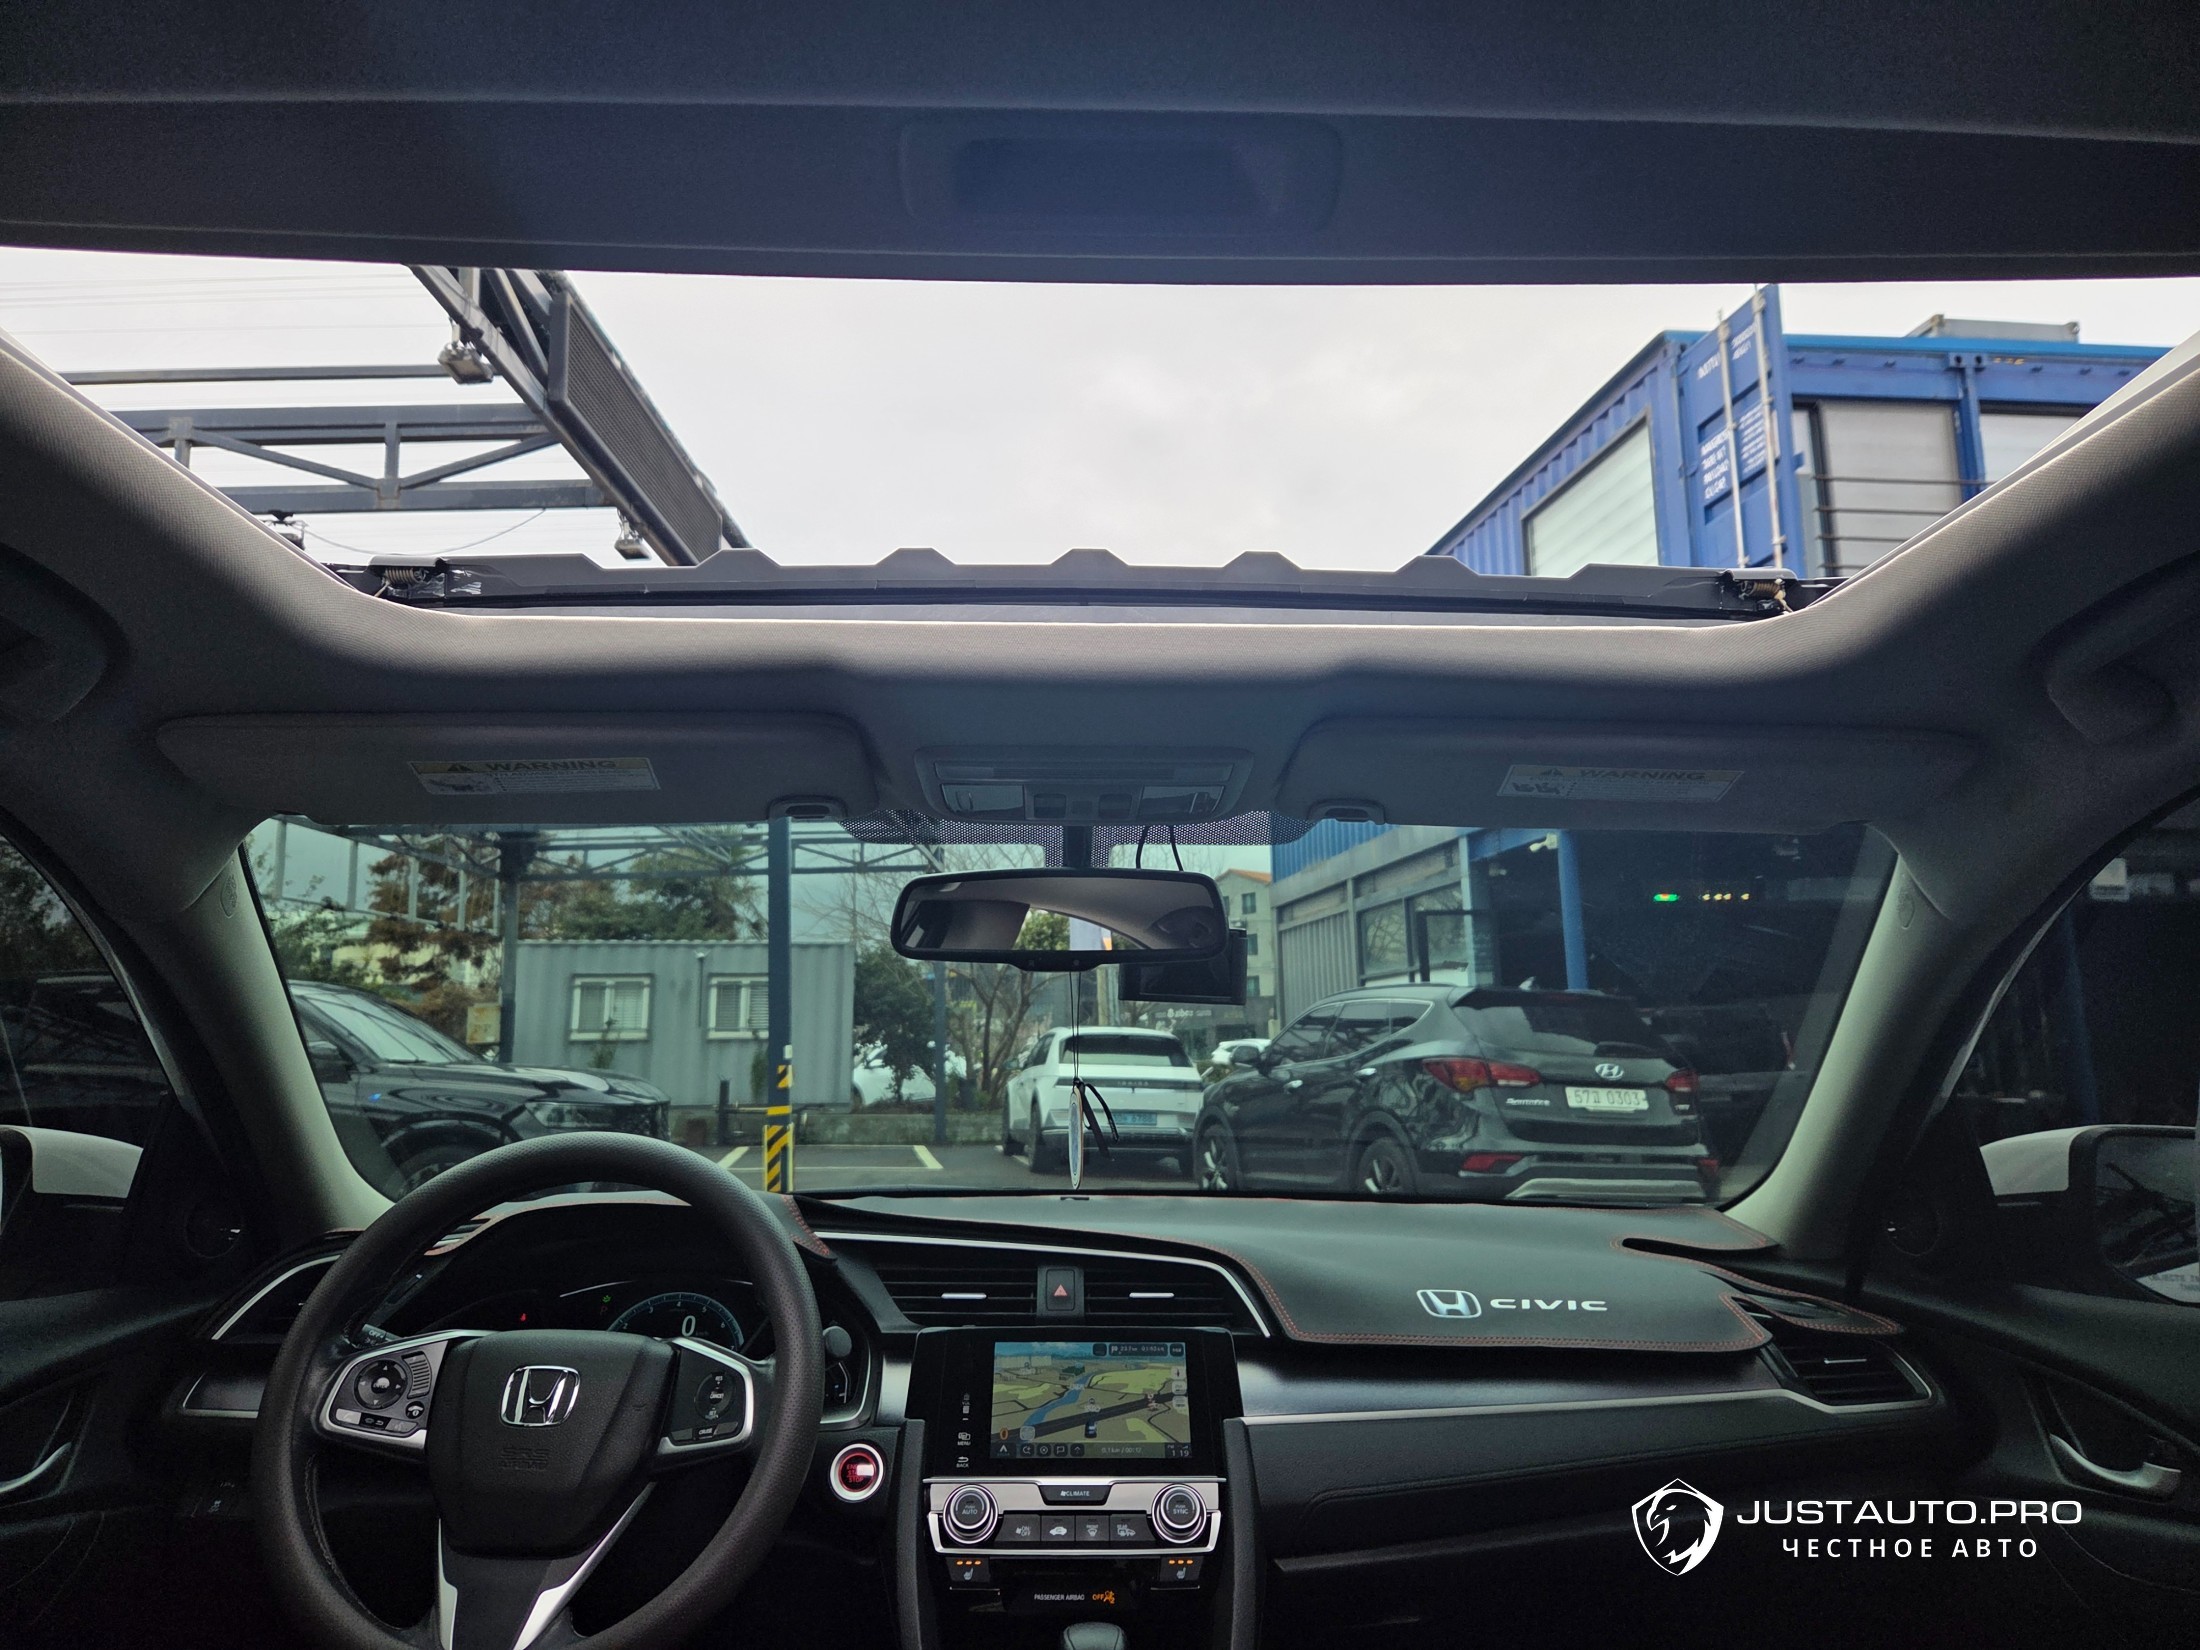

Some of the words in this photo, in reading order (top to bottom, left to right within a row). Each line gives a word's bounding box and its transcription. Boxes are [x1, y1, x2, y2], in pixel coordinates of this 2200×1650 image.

[485, 760, 617, 771] WARNING
[1579, 768, 1707, 781] WARNING
[1606, 1090, 1640, 1106] 0303
[1490, 1298, 1608, 1312] CIVIC
[681, 1315, 696, 1337] 0
[1065, 1489, 1090, 1497] CLIMATE
[1034, 1593, 1065, 1601] PASSENGER
[1066, 1593, 1085, 1601] AIRBAG
[1092, 1593, 1104, 1601] OFF
